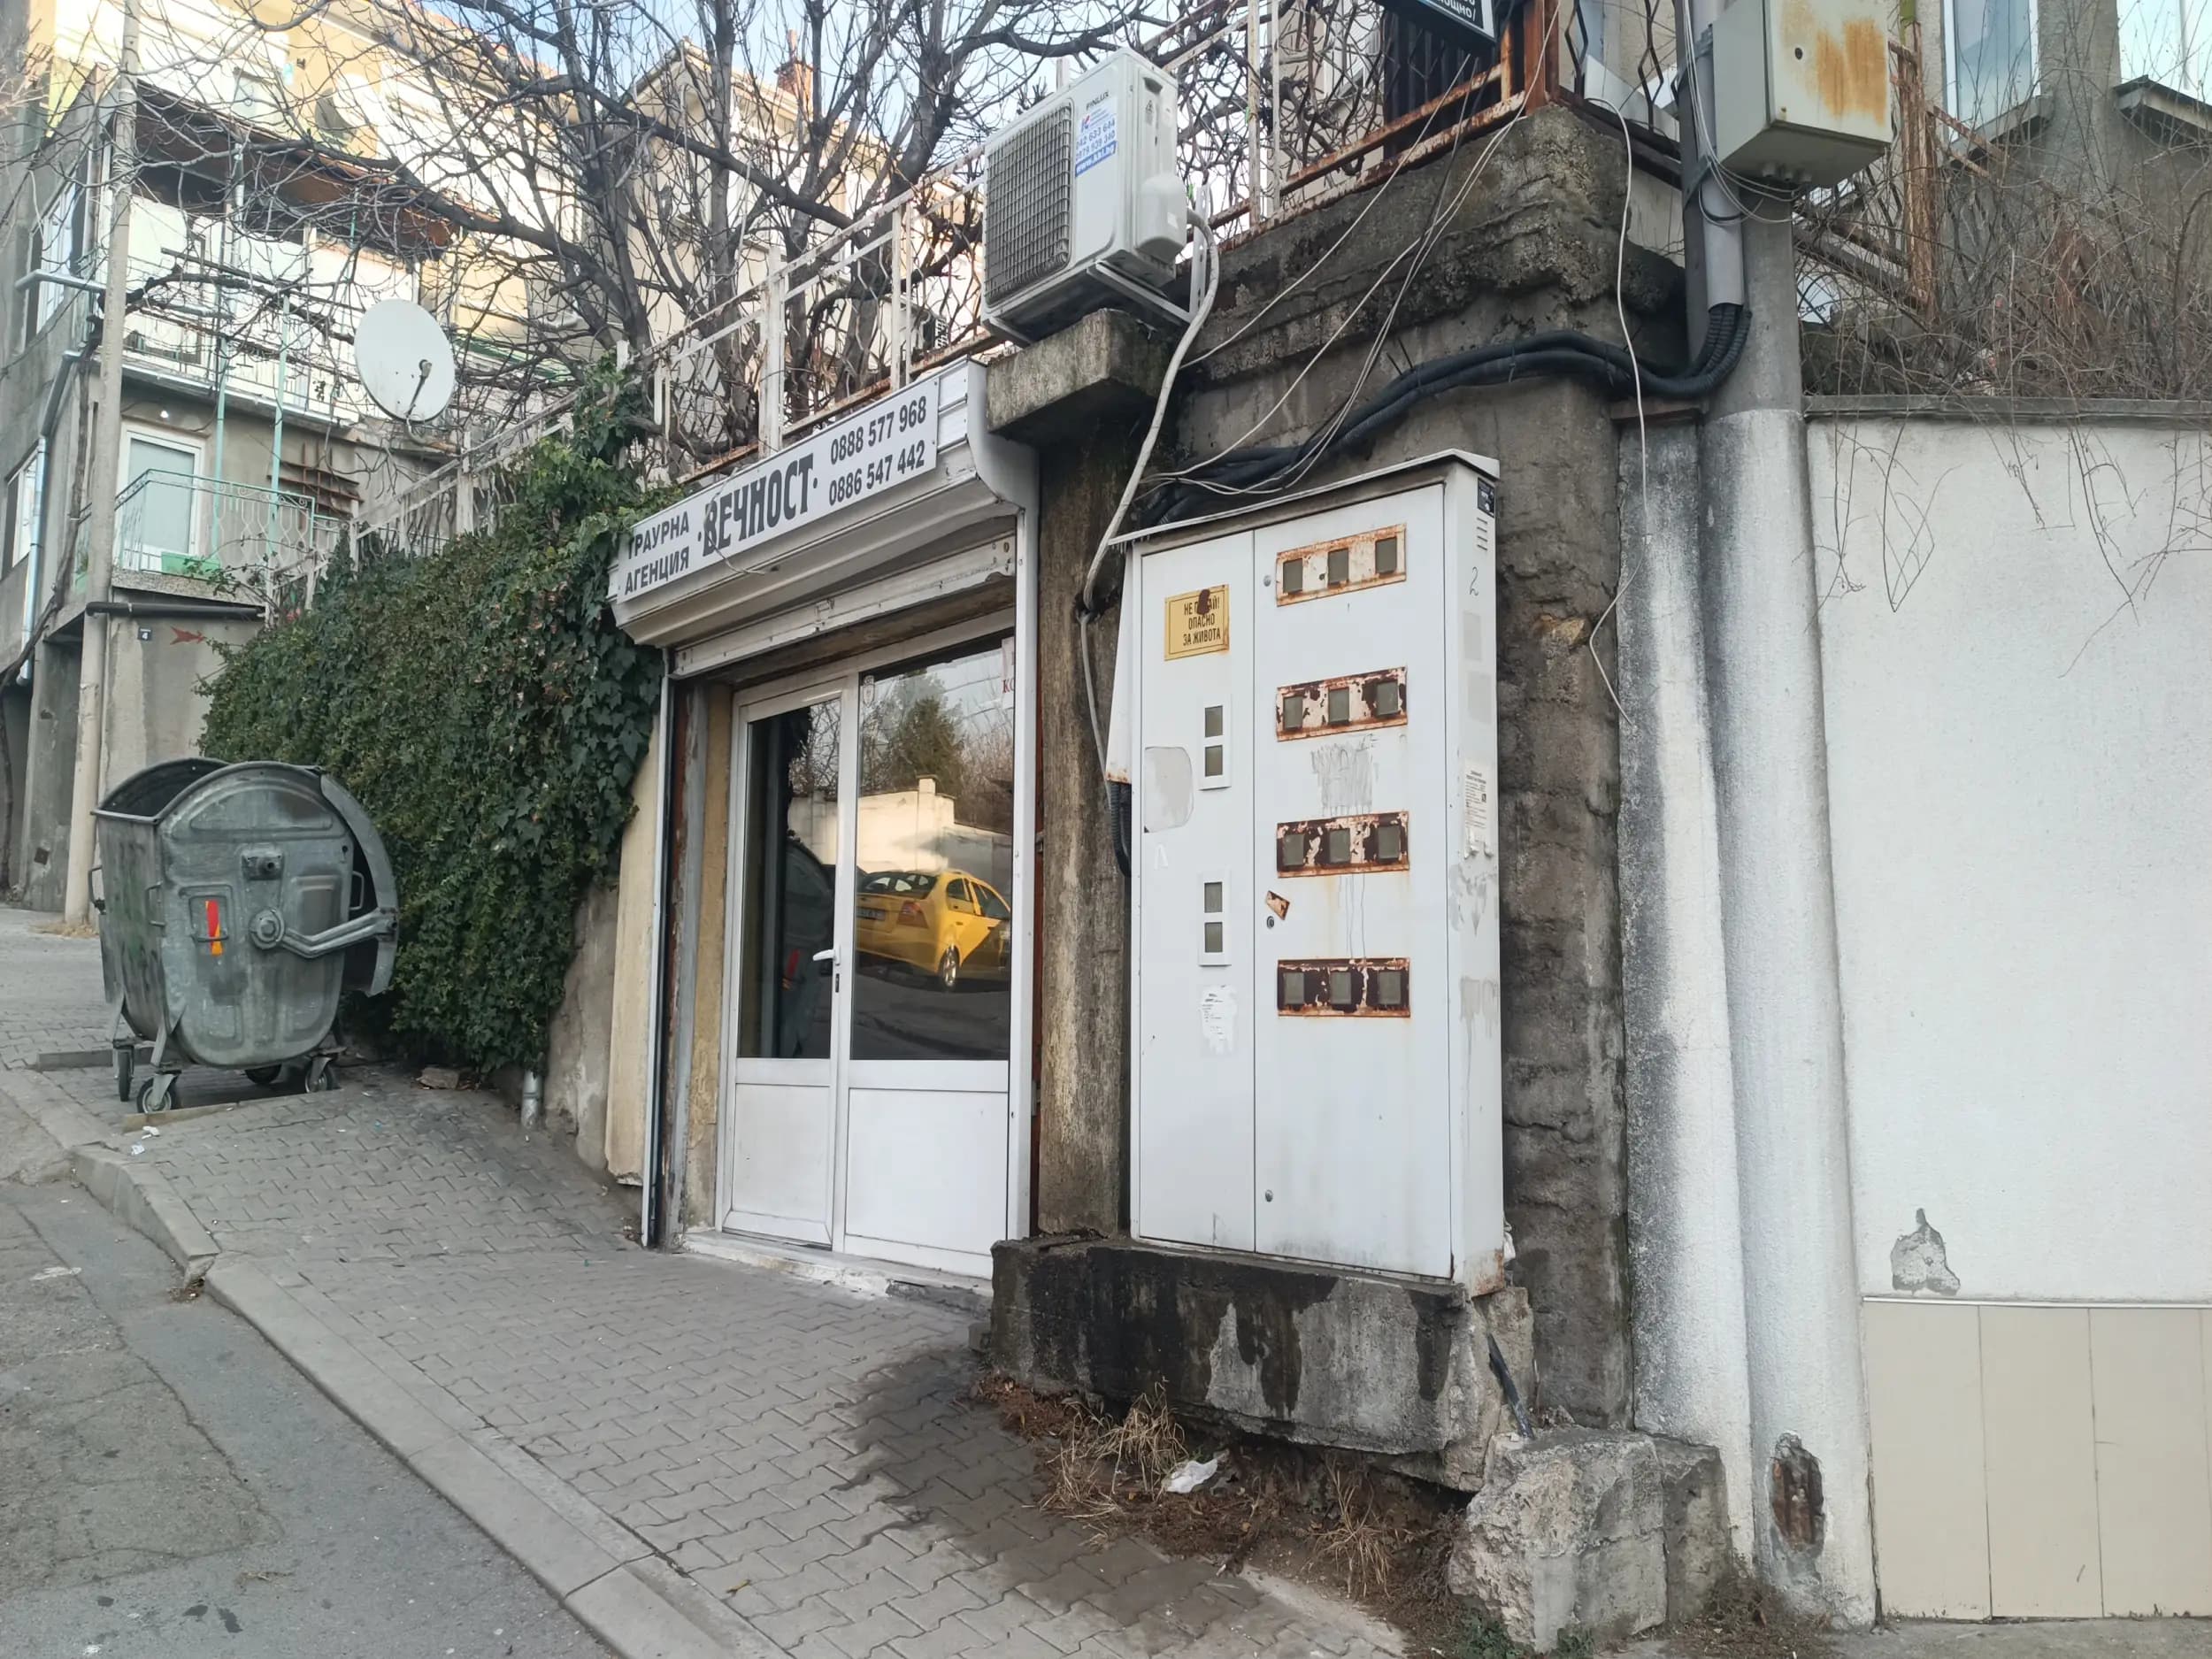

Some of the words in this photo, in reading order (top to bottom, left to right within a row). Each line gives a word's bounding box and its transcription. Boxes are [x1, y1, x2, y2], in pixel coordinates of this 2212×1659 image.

[830, 426, 864, 465] 0888
[868, 411, 895, 447] 577
[899, 396, 926, 432] 968
[829, 468, 862, 506] 0886
[866, 454, 893, 489] 547
[897, 440, 925, 474] 442
[627, 511, 689, 559] ТРАУРНА
[625, 546, 689, 595] АГЕНЦИЯ
[1184, 602, 1193, 615] НЕ
[1194, 595, 1220, 613] ПАЙ!
[1188, 613, 1215, 630] ОПАСНО
[1183, 634, 1192, 646] ЗА
[1193, 627, 1221, 644] ЖИВОТА
